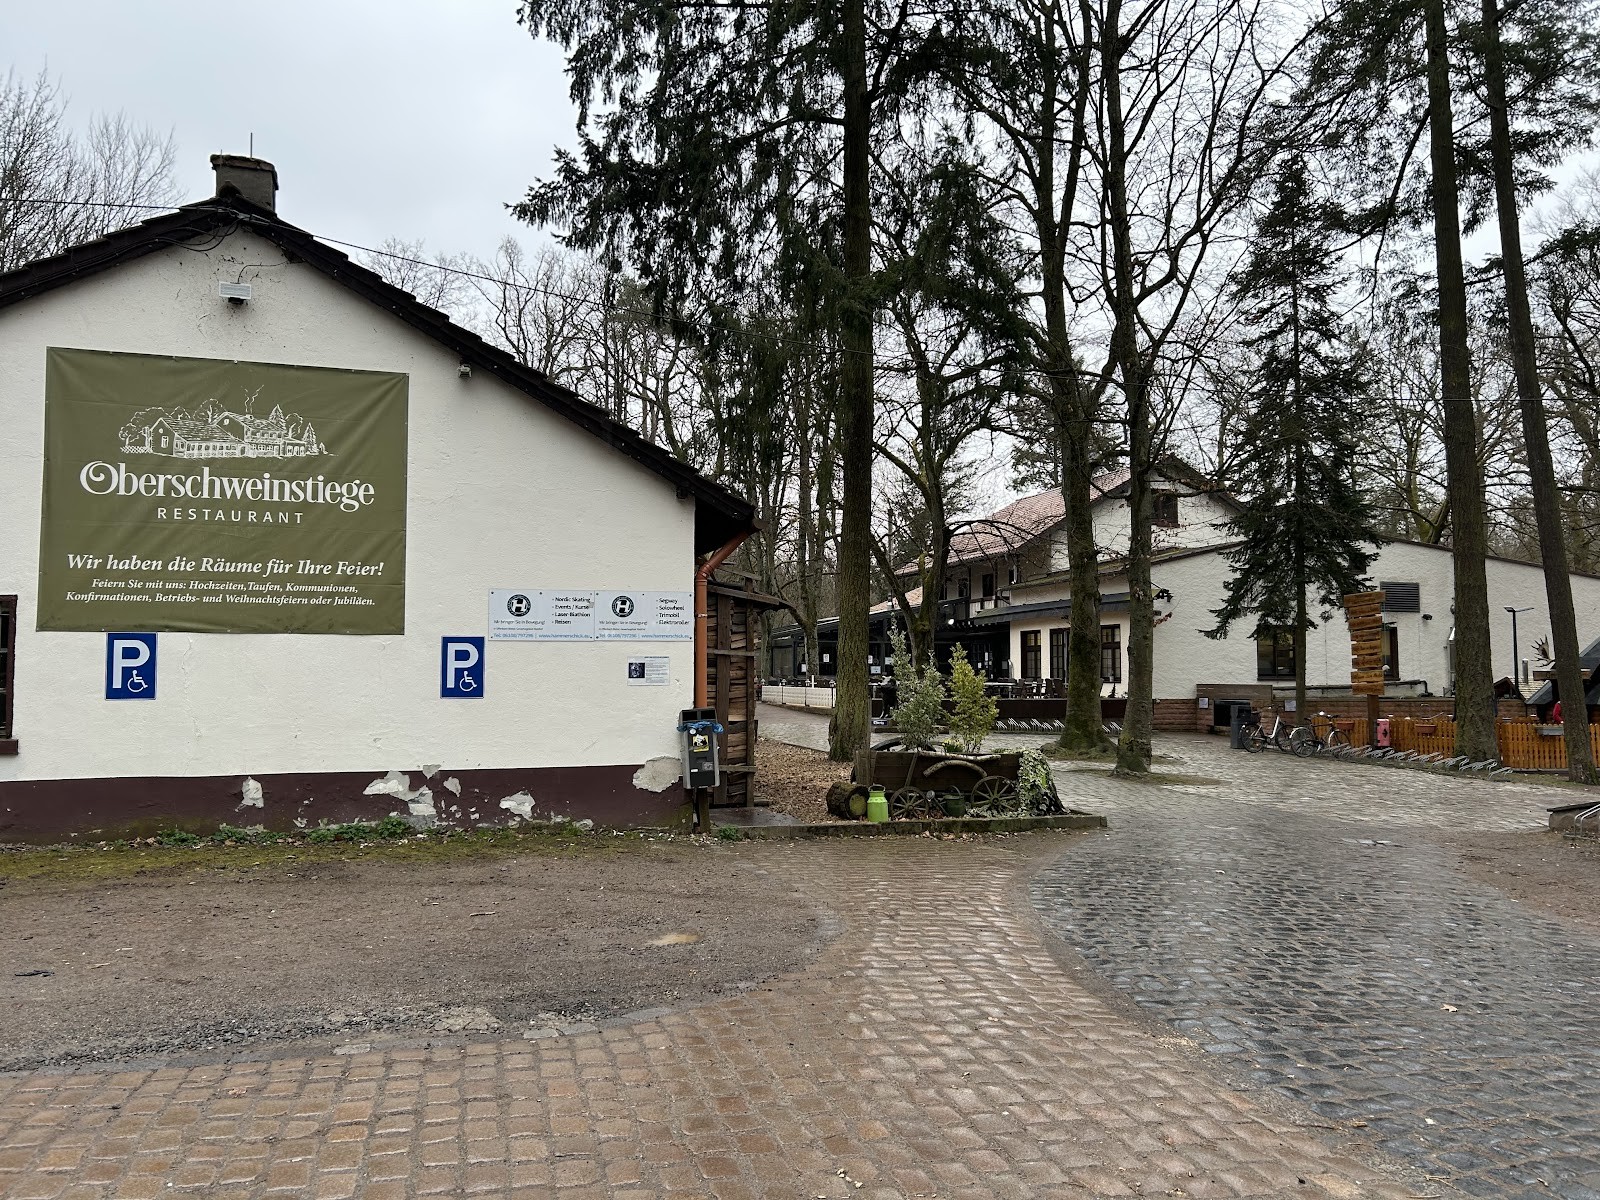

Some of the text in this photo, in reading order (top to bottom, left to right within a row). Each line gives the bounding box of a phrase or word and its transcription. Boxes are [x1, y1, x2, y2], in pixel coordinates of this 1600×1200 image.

[79, 460, 375, 512] Oberschweinstiege
[157, 507, 304, 524] RESTAURANT
[67, 553, 385, 577] Wir haben die Räume für Ihre Feier!
[92, 578, 358, 594] Feiern Sie mit uns: Hochzeiten, Taufen, Kommunionen,
[65, 591, 376, 606] Konfirmationen, Betriebs- und Weihnachtsfeiern oder Jubiläen.
[112, 639, 151, 689] P
[446, 642, 480, 689] P
